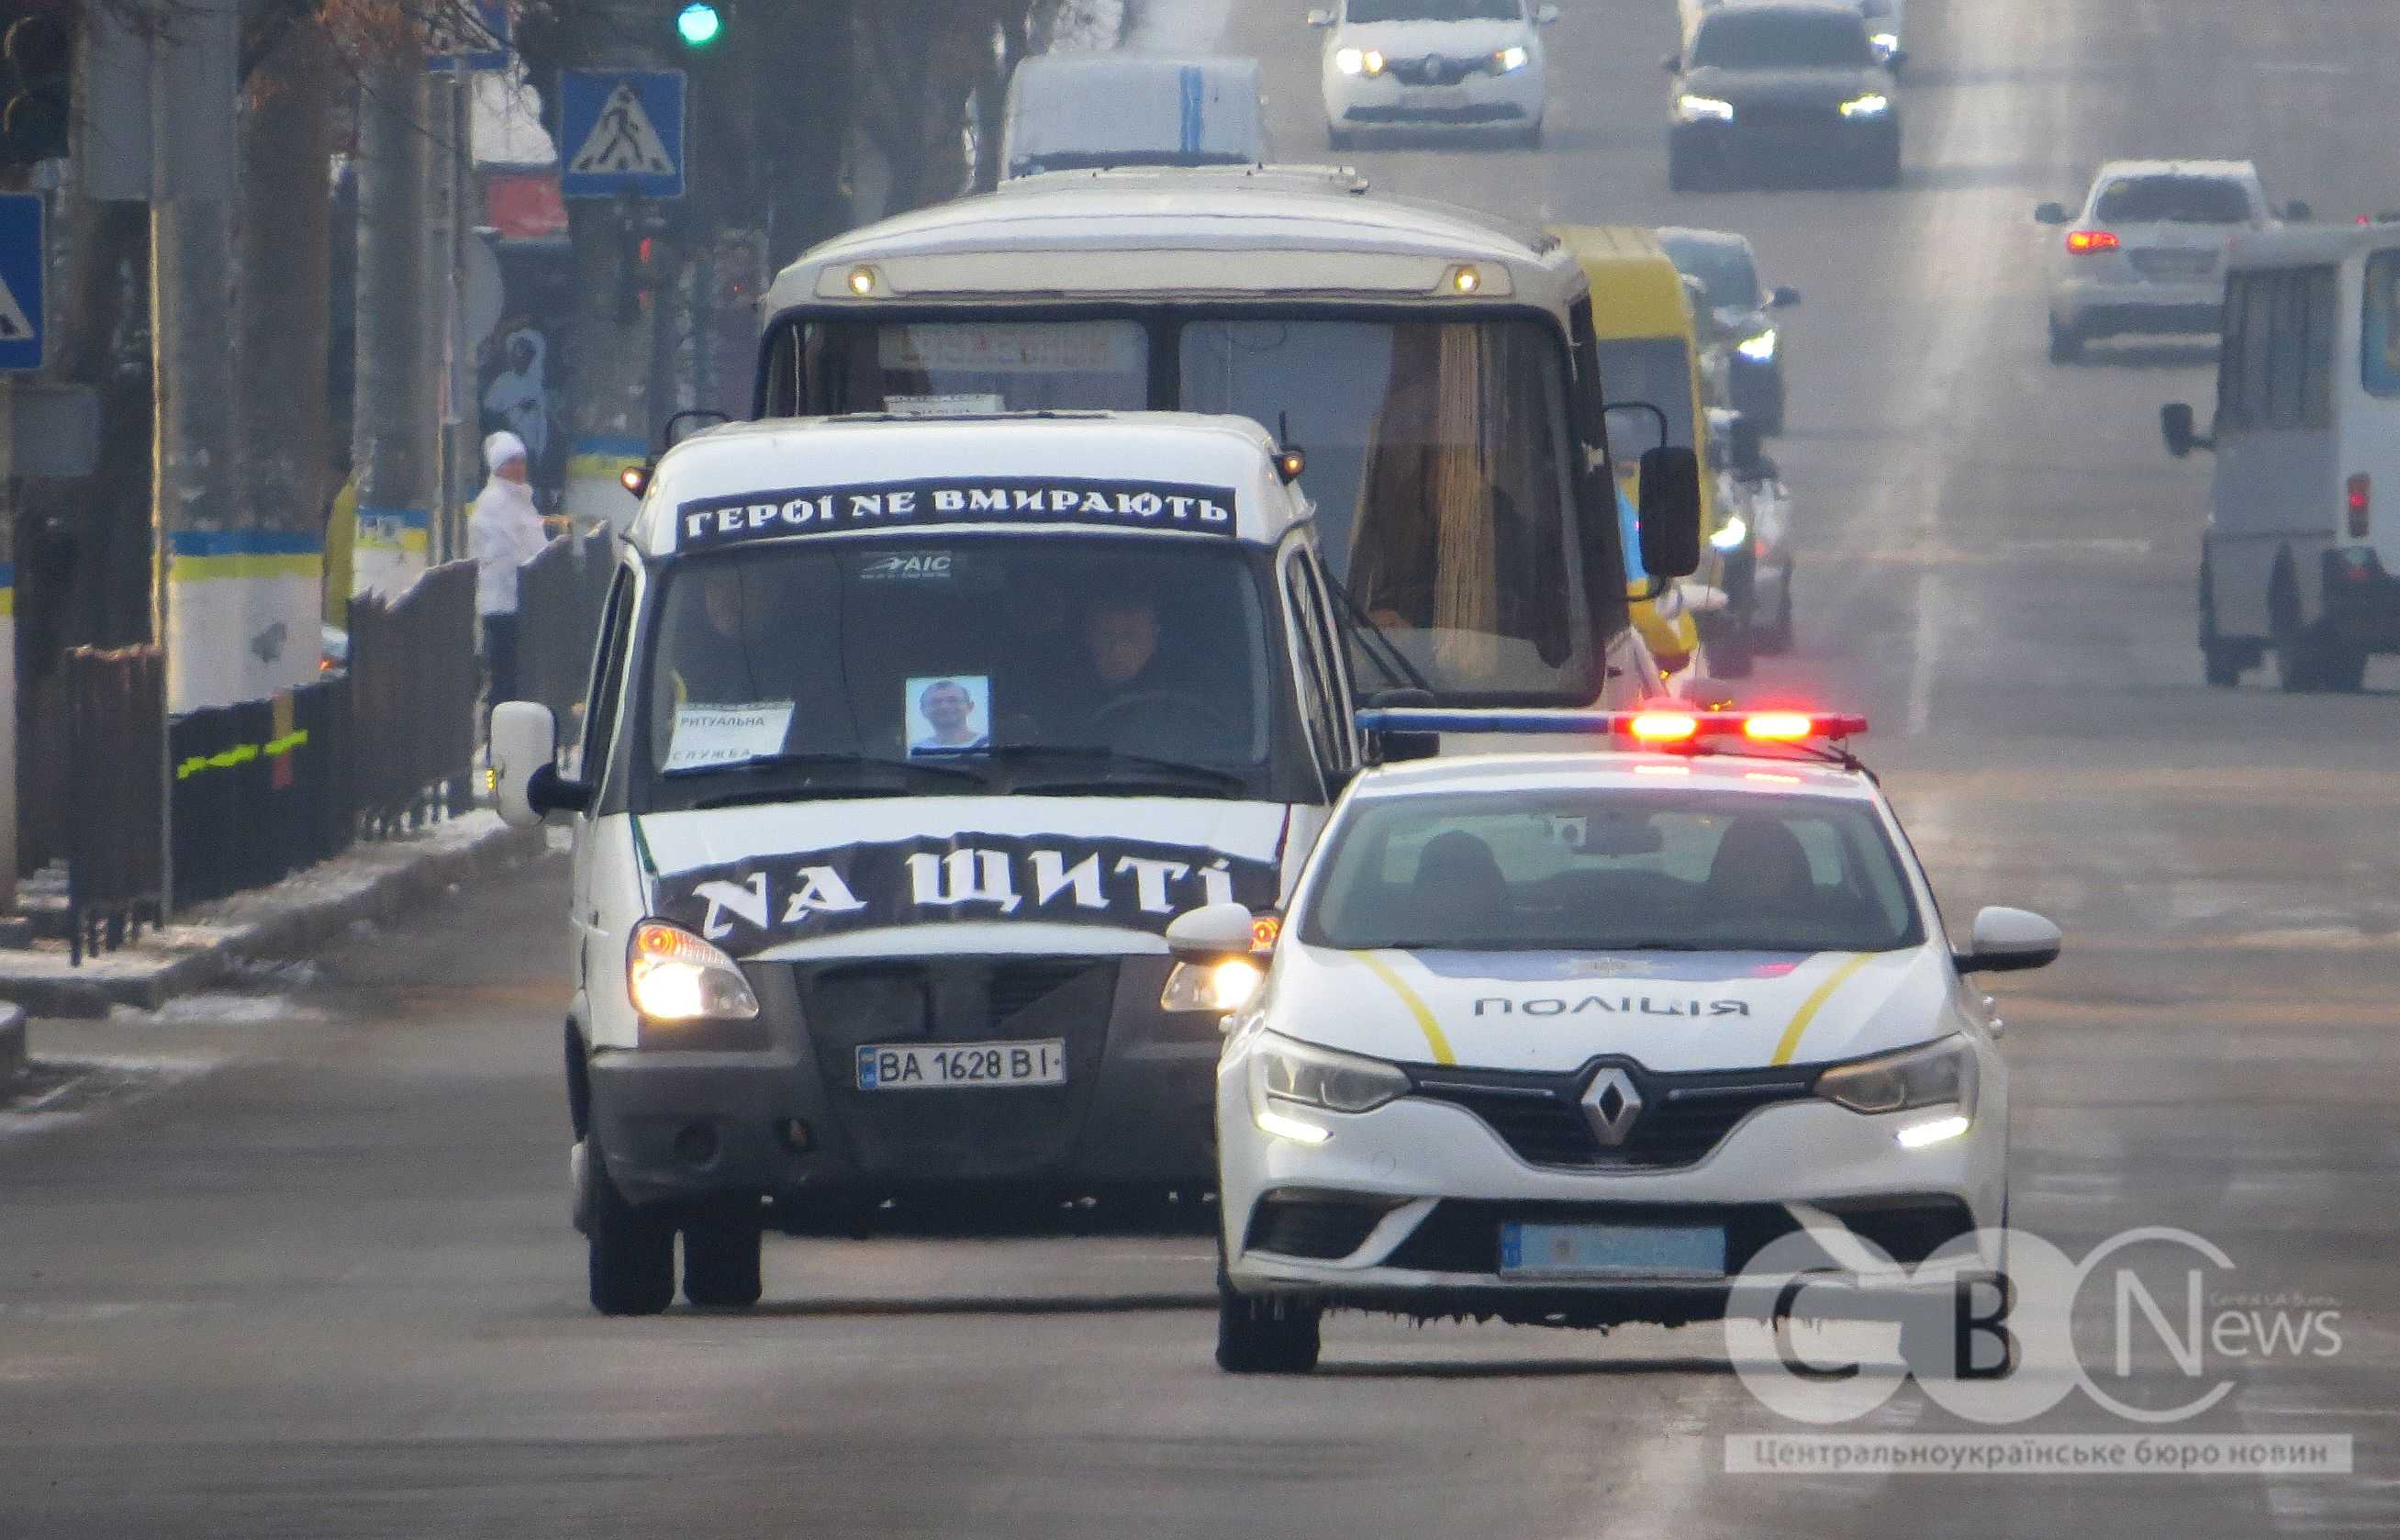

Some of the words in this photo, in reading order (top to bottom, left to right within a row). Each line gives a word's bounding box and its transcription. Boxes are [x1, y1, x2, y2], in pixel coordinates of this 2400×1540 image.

[932, 488, 1228, 521] ВМИРАЮТЬ
[680, 715, 765, 728] РИТУАЛЬНА
[1474, 995, 1750, 1016] ПОЛІЦІЯ
[933, 1049, 1001, 1080] 1628
